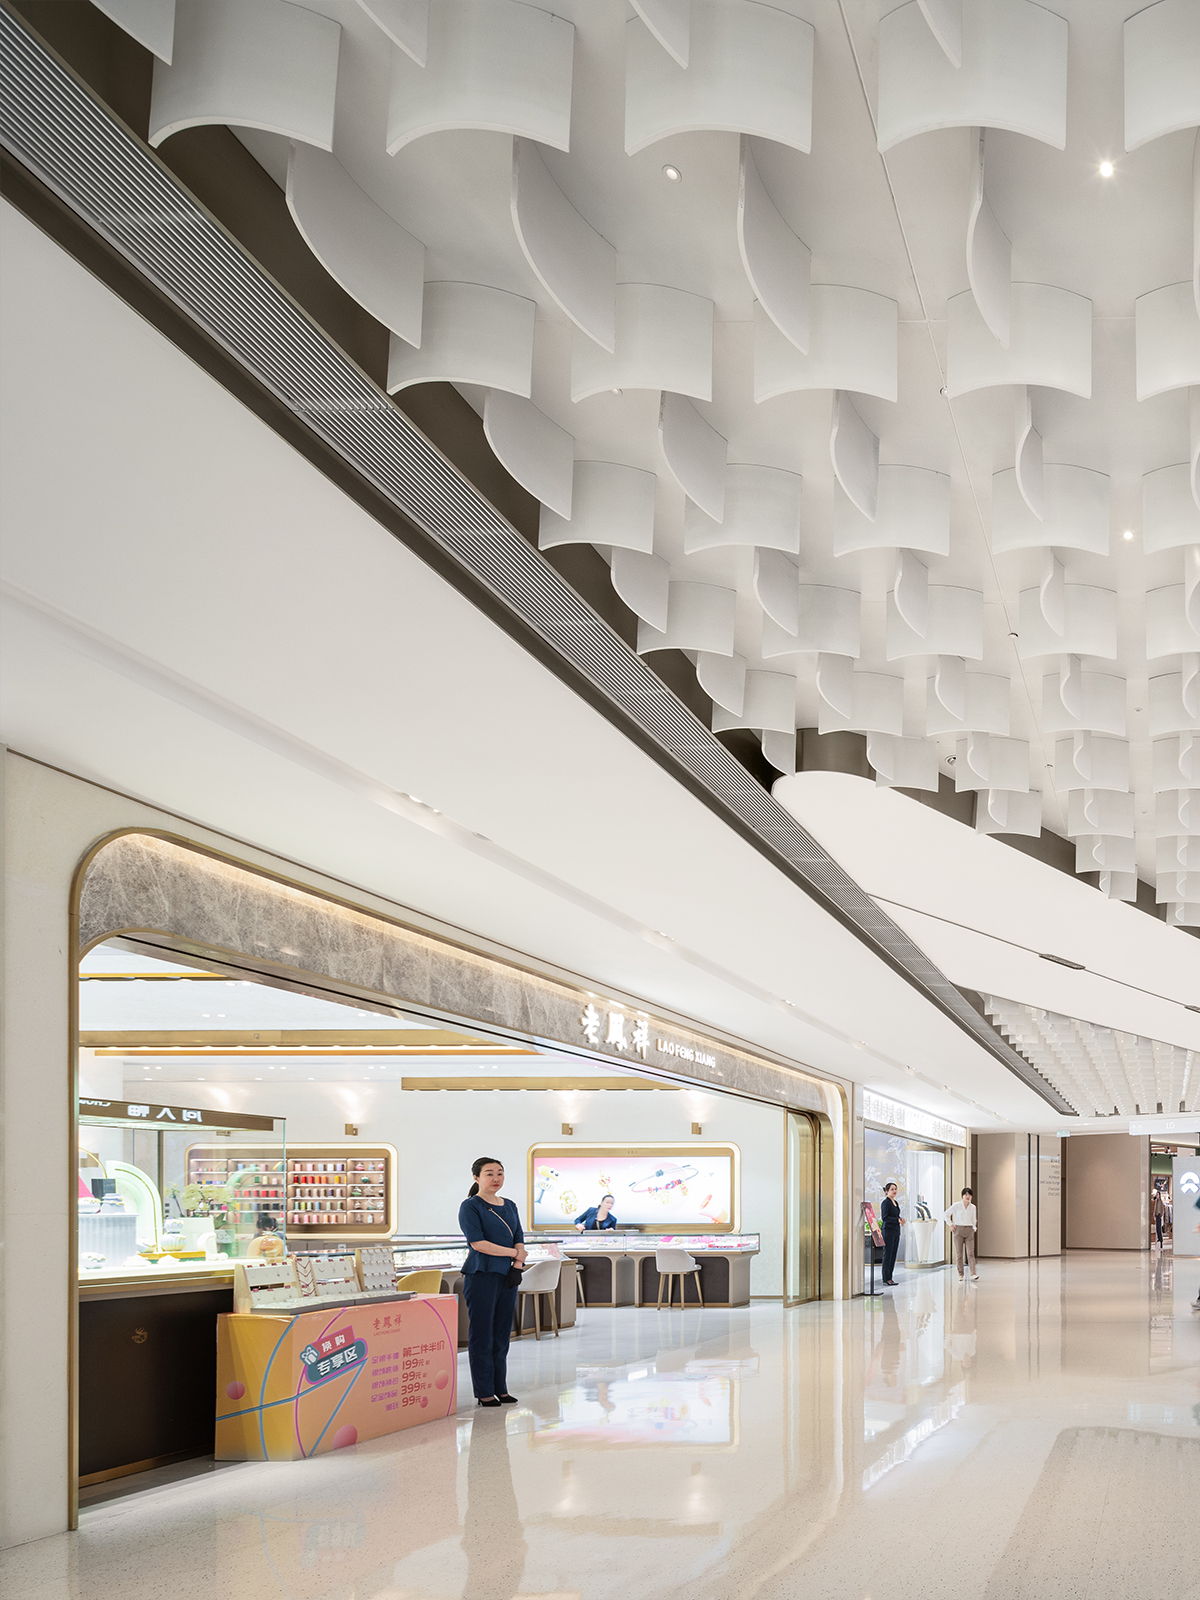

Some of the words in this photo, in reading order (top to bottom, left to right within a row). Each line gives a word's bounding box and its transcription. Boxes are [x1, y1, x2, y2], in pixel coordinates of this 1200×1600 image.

[656, 1039, 675, 1054] LAO
[676, 1043, 694, 1062] FENG
[694, 1051, 716, 1068] XIANG
[1165, 1121, 1176, 1130] LG
[402, 1340, 445, 1358] 第二件半价
[317, 1346, 358, 1376] 专享区
